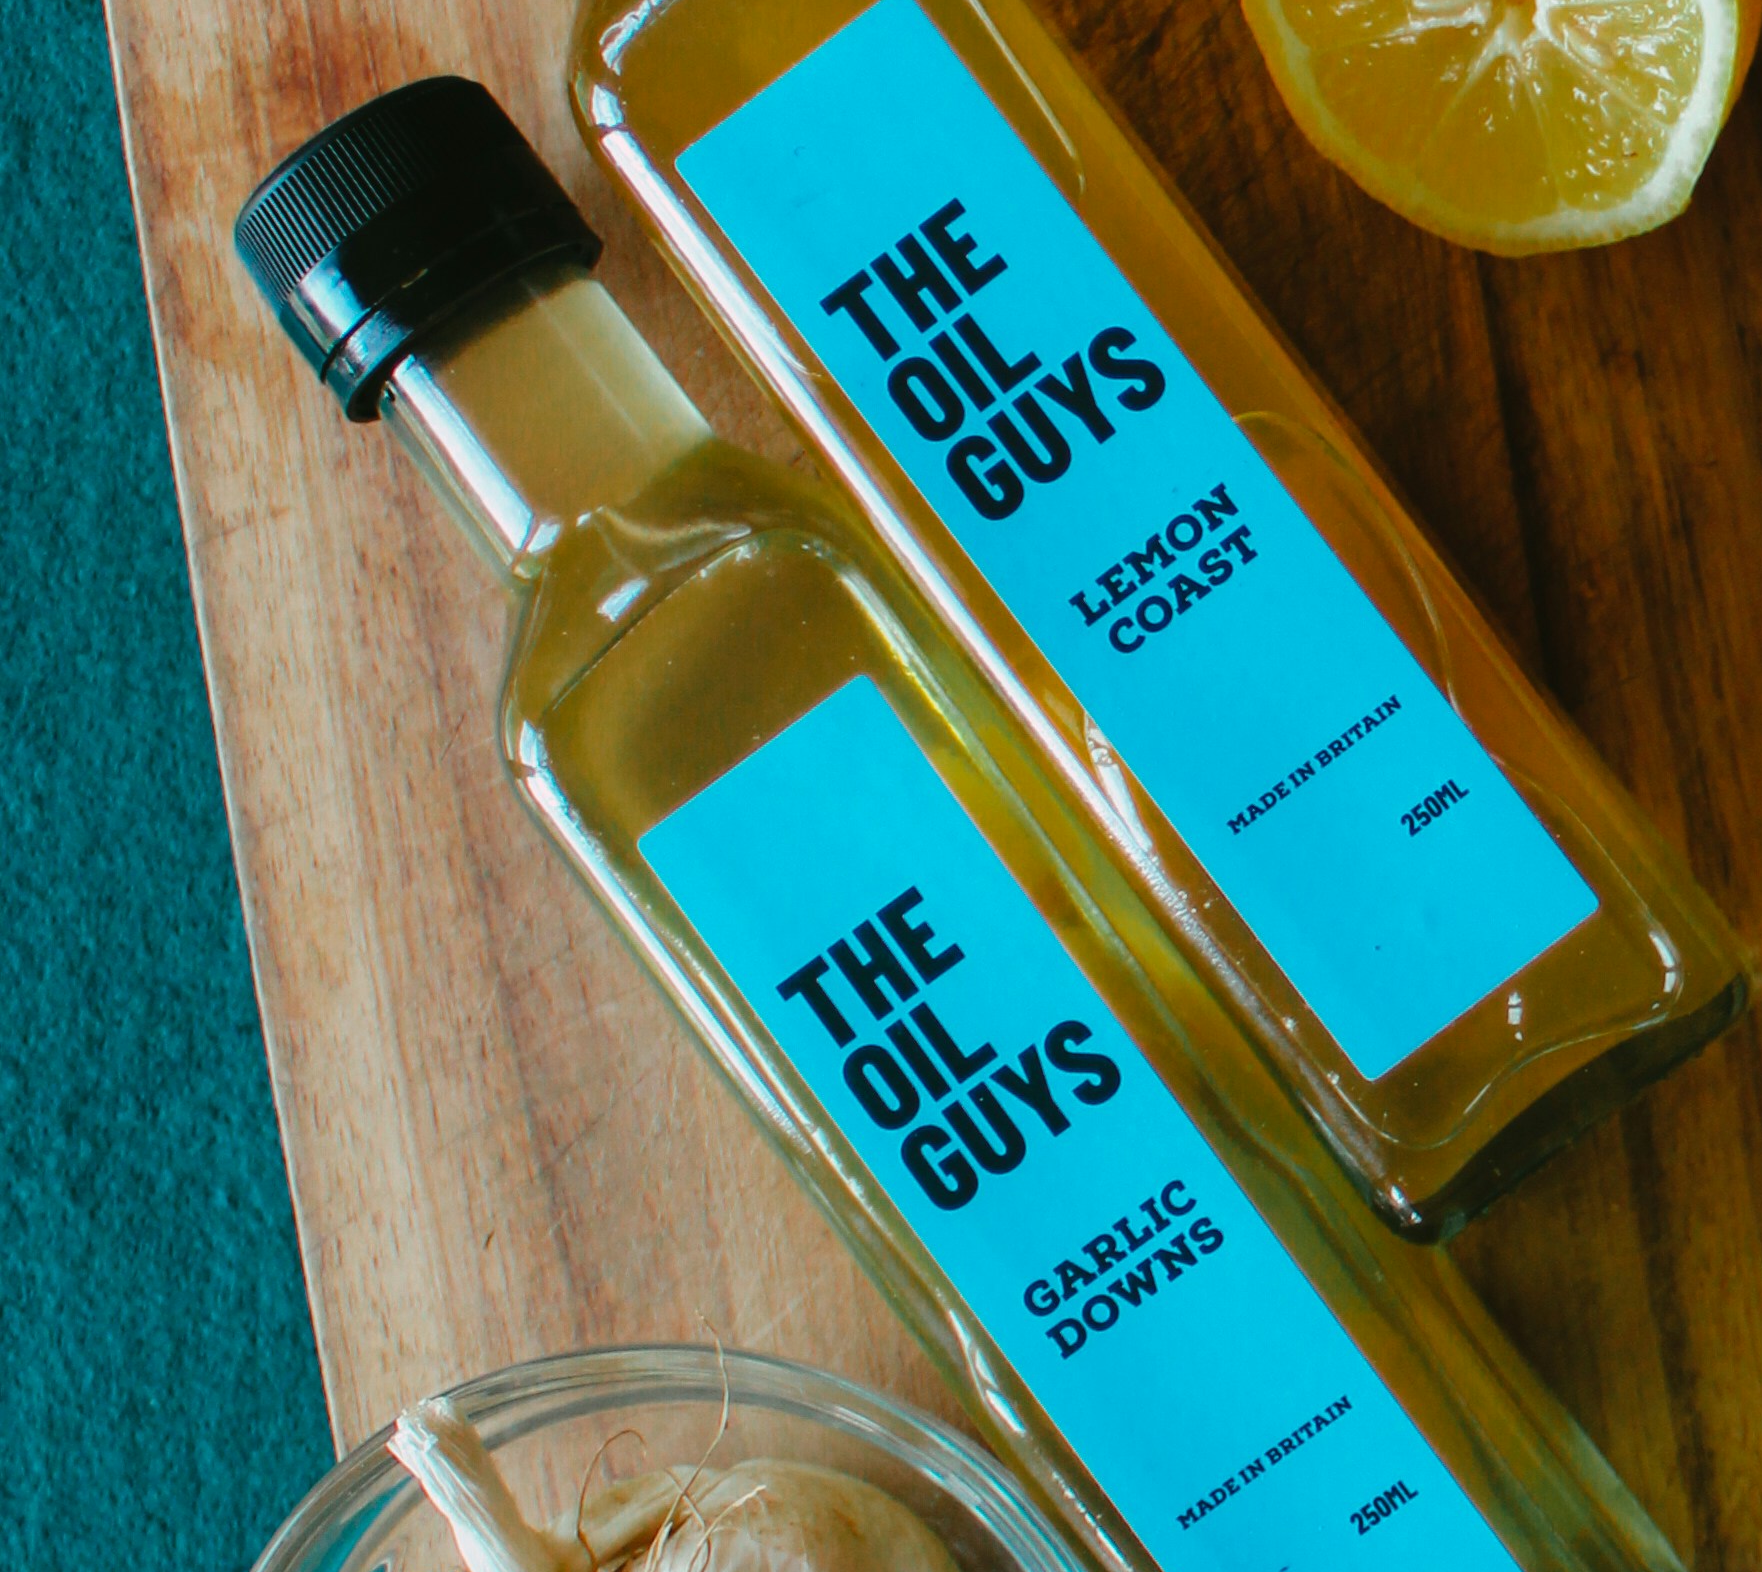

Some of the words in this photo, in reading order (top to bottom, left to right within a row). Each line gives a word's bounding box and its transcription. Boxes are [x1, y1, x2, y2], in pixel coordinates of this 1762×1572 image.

[819, 197, 1009, 363] THE
[886, 312, 1043, 443] OIL
[945, 326, 1167, 522] GUYS
[1068, 482, 1240, 628] LEMON
[1108, 524, 1259, 654] COAST
[1226, 780, 1292, 836] MADE
[1287, 760, 1316, 789] IN
[1313, 694, 1402, 768] BRITAIN
[1400, 779, 1470, 837] 250ML
[775, 885, 966, 1049] THE
[842, 1001, 999, 1131] OIL
[900, 1019, 1122, 1211] GUYS
[1023, 1179, 1197, 1317] GARLIC
[1045, 1216, 1225, 1360] DOWNS
[1176, 1477, 1241, 1531] MADE
[1237, 1457, 1266, 1485] IN
[1264, 1395, 1353, 1466] BRITAIN
[1349, 1480, 1419, 1536] 250ML
